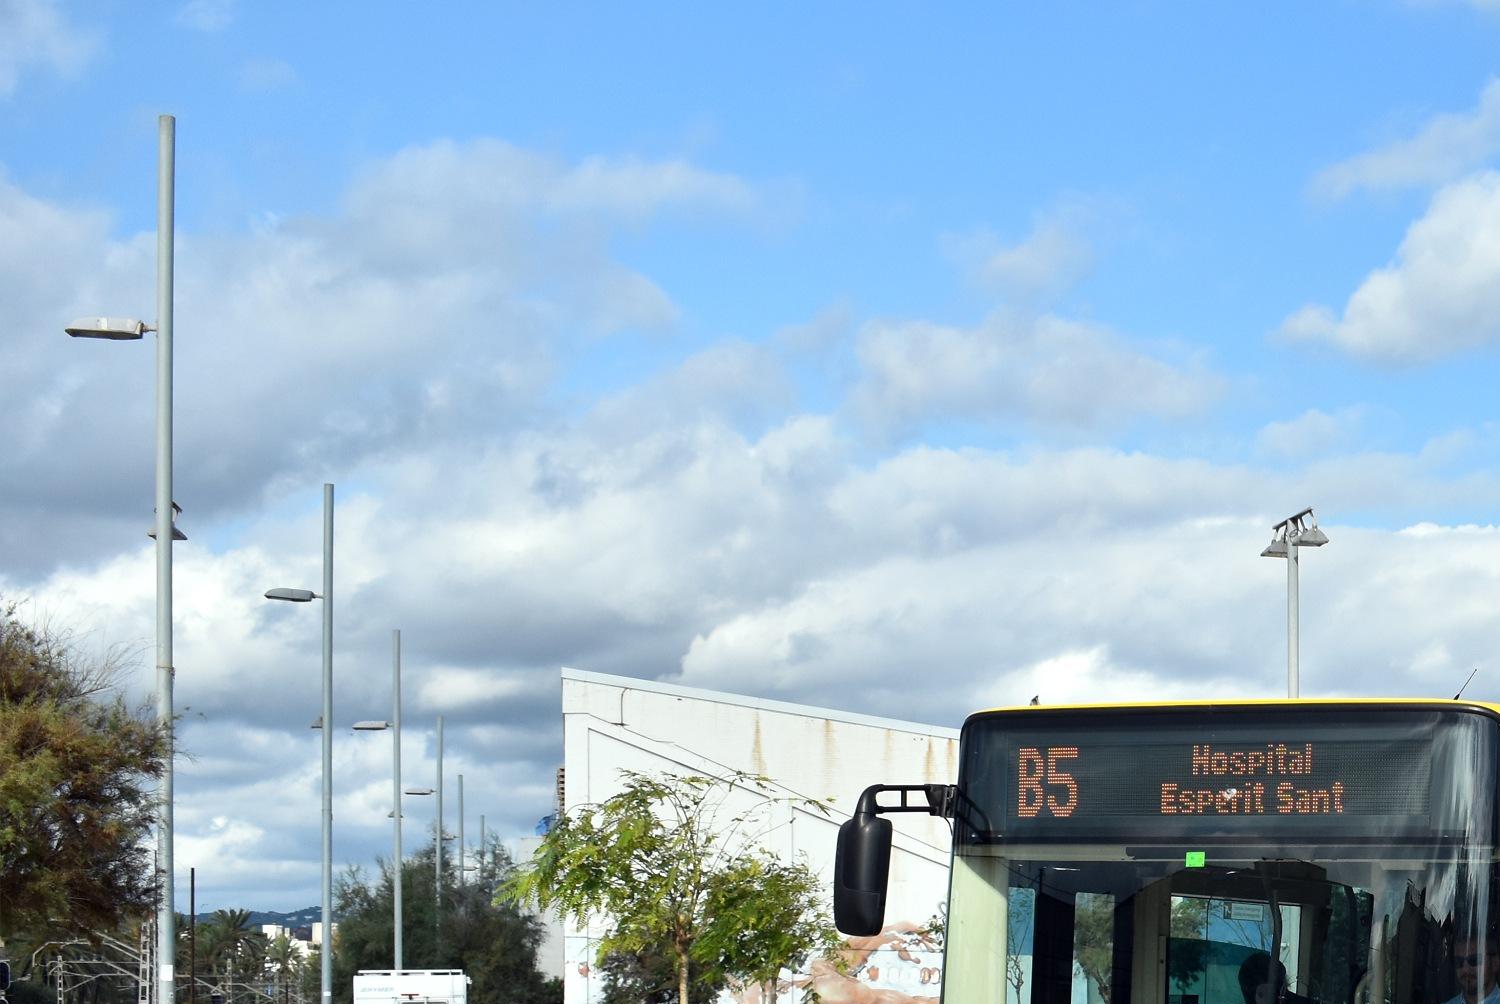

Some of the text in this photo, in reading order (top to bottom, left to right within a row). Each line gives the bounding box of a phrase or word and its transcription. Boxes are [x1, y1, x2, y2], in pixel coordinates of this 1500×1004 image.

[1192, 743, 1312, 775] Hospital
[1018, 747, 1078, 817] B5
[1161, 781, 1344, 813] Esperit Sant
